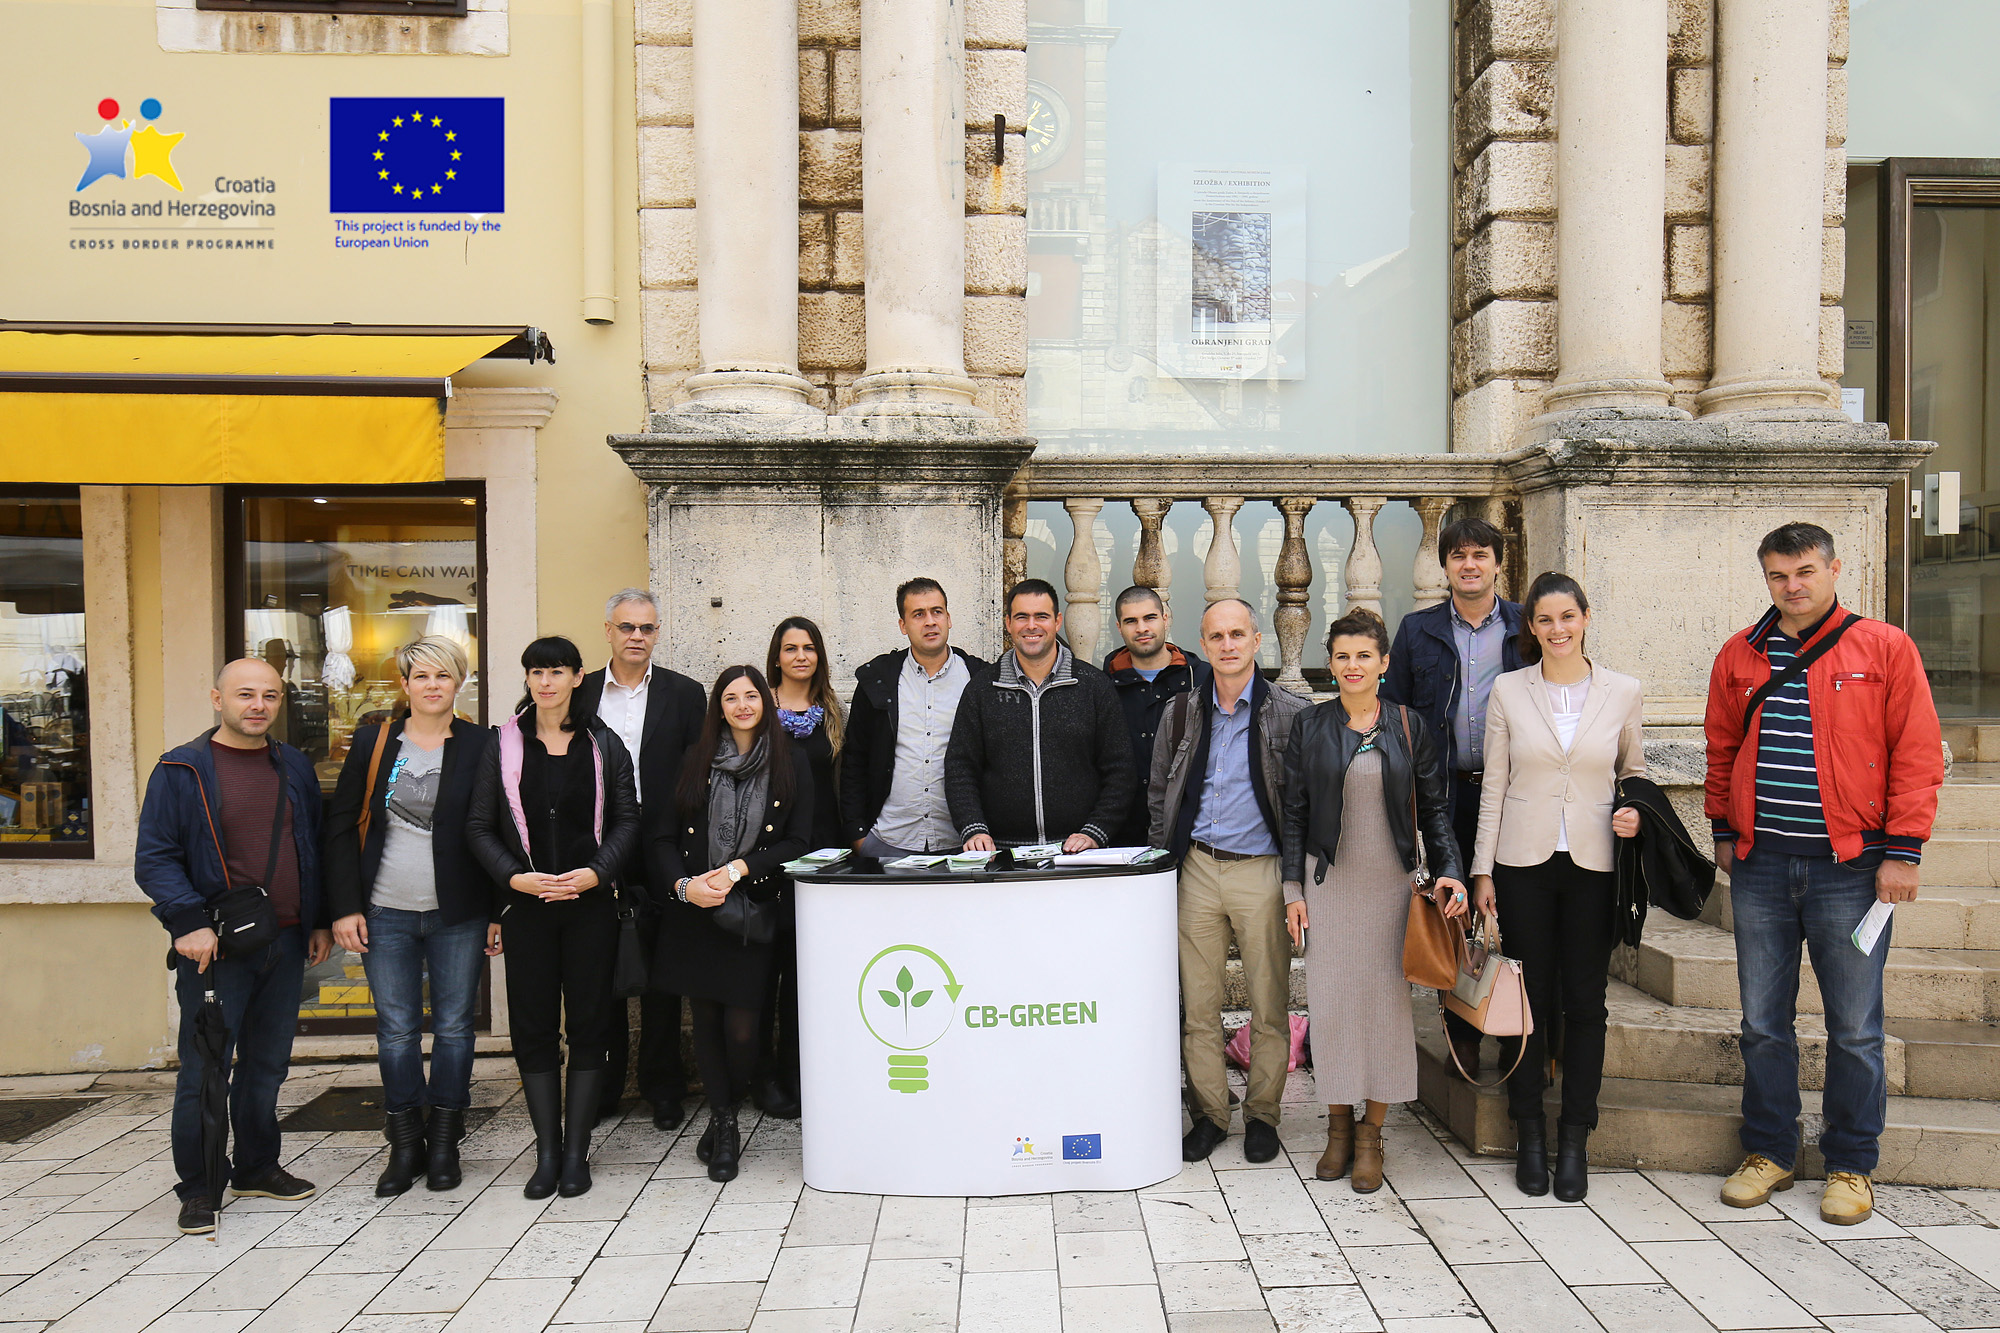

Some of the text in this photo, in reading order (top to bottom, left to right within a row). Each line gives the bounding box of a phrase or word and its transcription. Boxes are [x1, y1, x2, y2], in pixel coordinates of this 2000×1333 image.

[1191, 338, 1243, 347] OBRANJENI
[347, 564, 390, 578] TIME
[396, 565, 435, 578] CAN
[964, 1000, 1098, 1029] CB-GREEN
